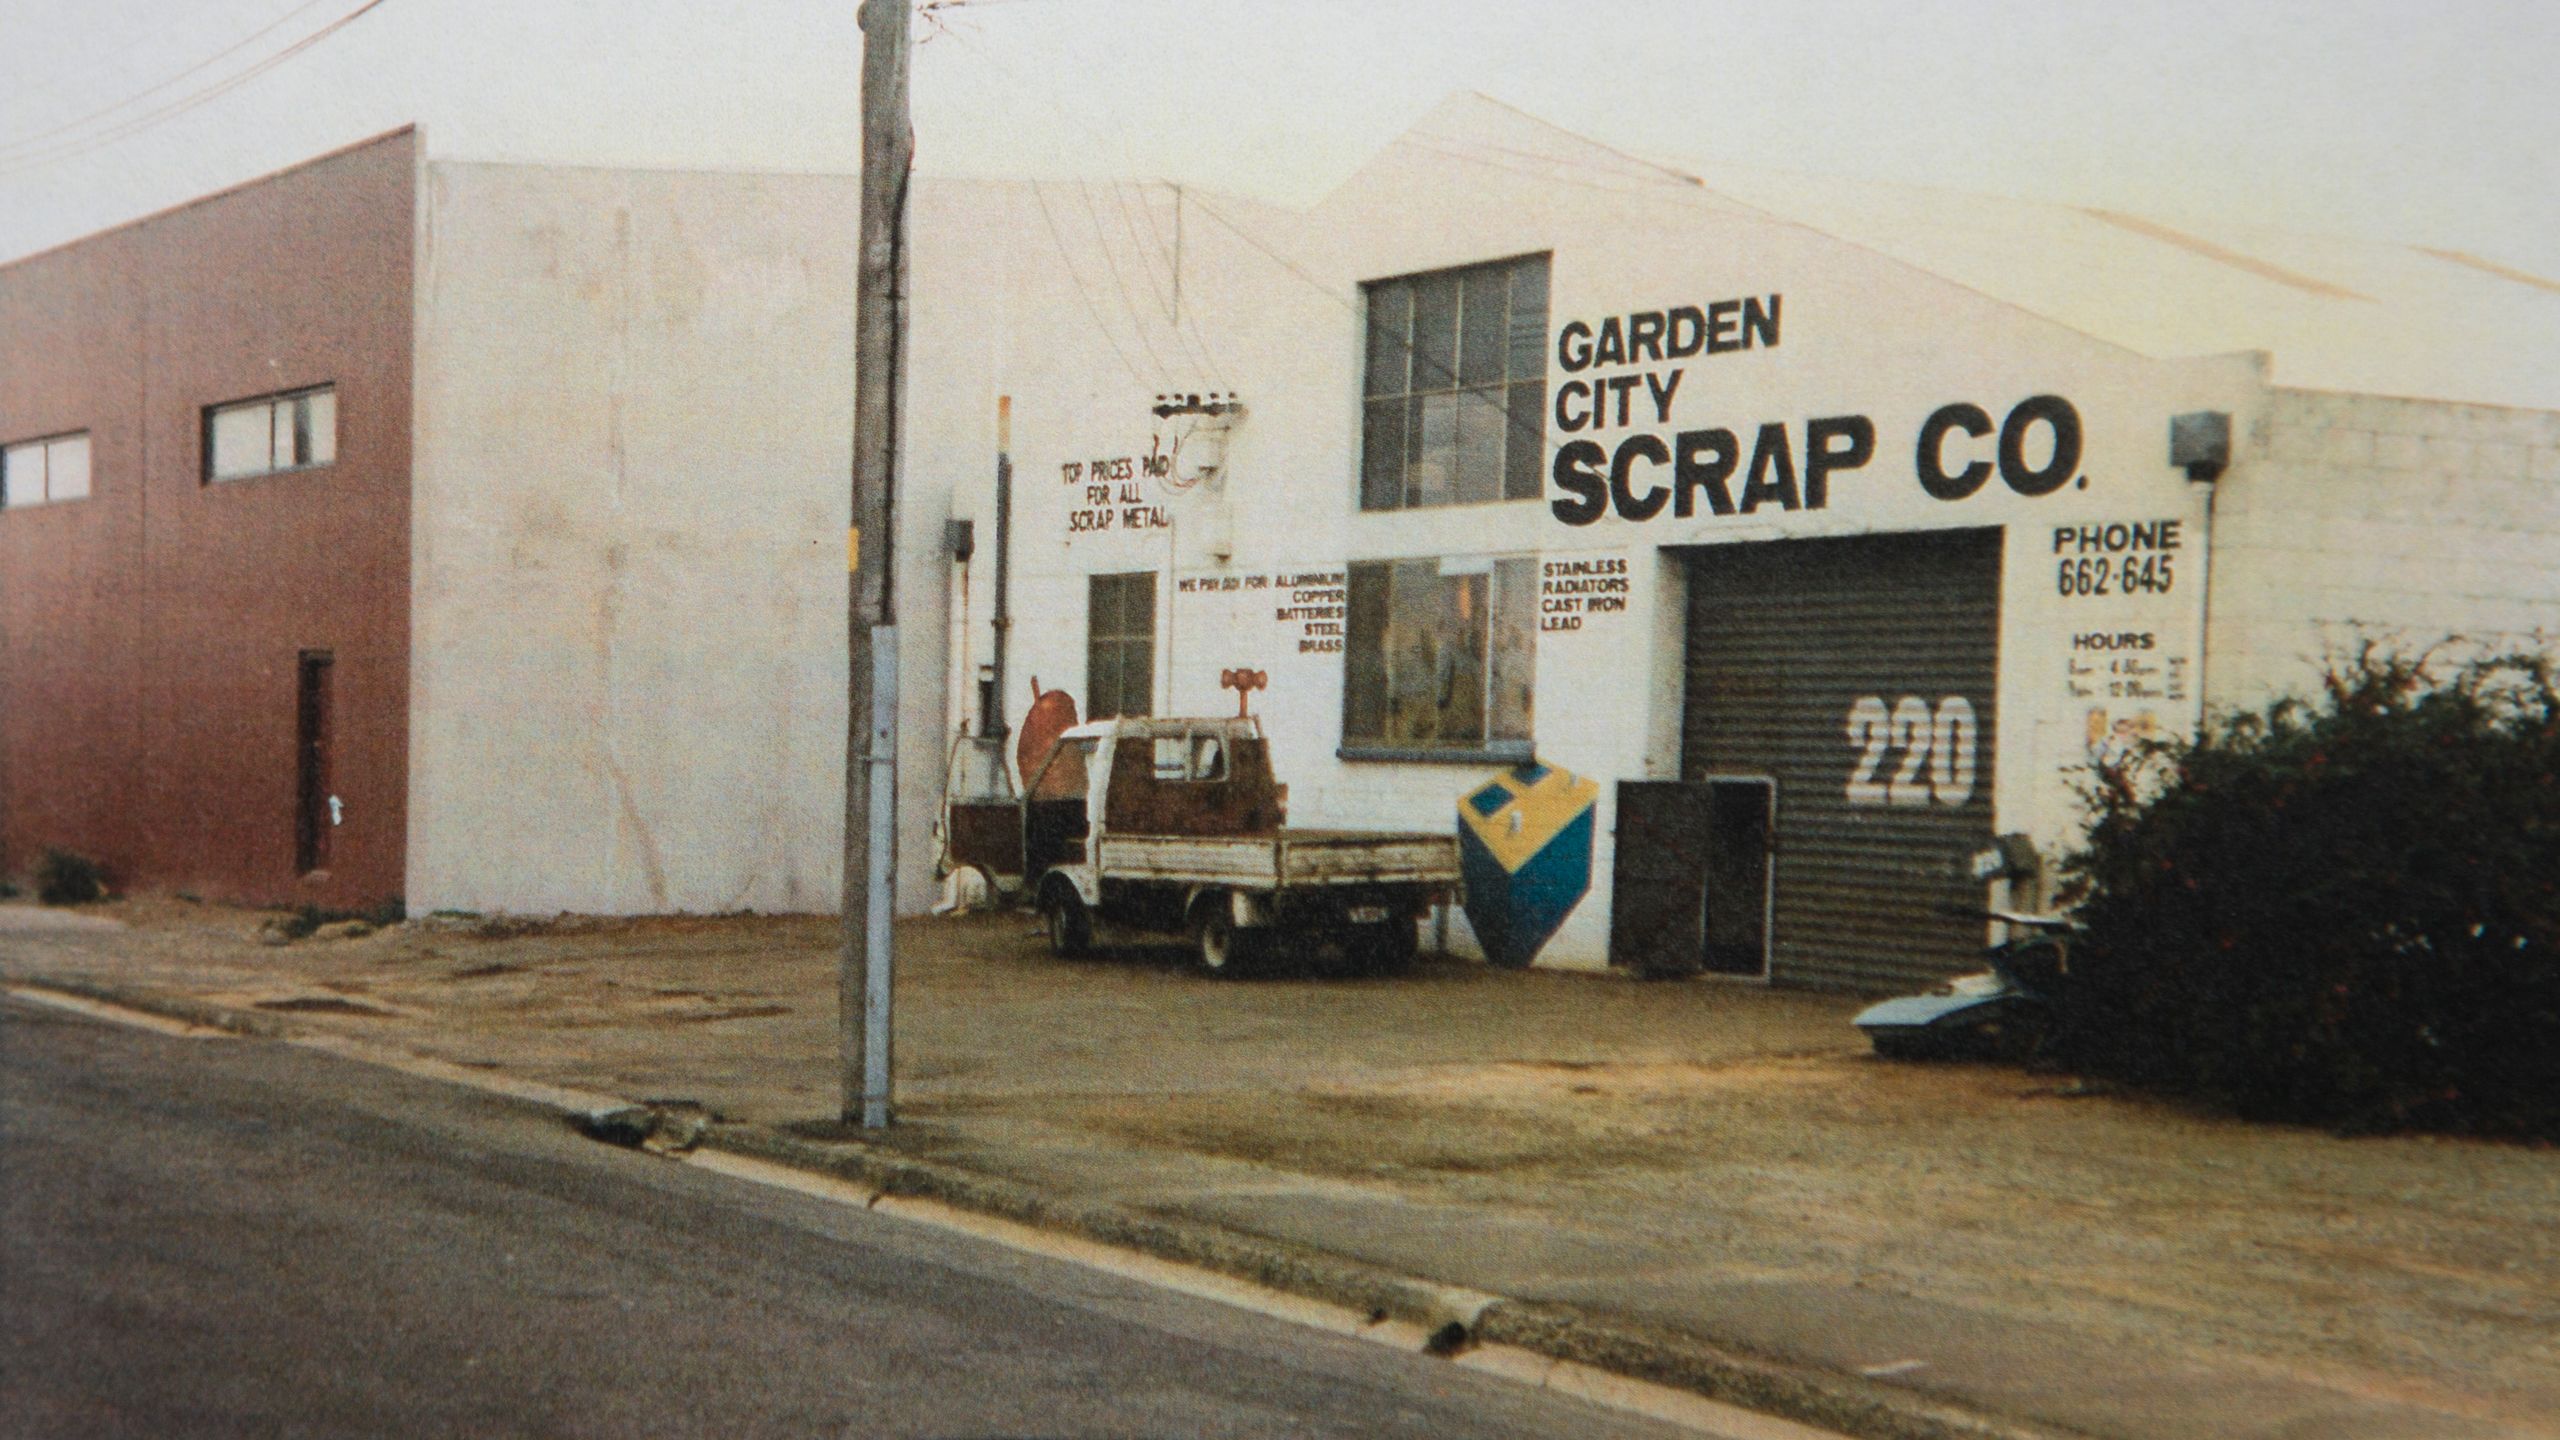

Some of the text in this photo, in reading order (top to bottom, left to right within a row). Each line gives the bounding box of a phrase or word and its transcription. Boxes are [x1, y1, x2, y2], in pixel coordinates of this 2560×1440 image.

[1558, 294, 1782, 374] GARDEN
[1554, 369, 1685, 433] CITY
[1062, 462, 1083, 485] TOP
[1091, 457, 1133, 482] PRICES
[1551, 394, 2090, 527] SCRAP CO.
[1087, 482, 1143, 506] FOR ALL
[1069, 506, 1169, 532] SCRAP METAL
[2053, 519, 2182, 554] PHONE
[1543, 558, 1628, 578] STAINLESS
[1293, 588, 1345, 604] COPPER
[1542, 577, 1629, 596] RADIATORS
[1277, 606, 1344, 621] BATTERIES
[1541, 596, 1627, 613] CAST IRON
[1305, 623, 1344, 636] STEEL
[1541, 616, 1582, 631] LEAD
[2073, 632, 2155, 650] HOURS
[1846, 694, 1976, 807] 220
